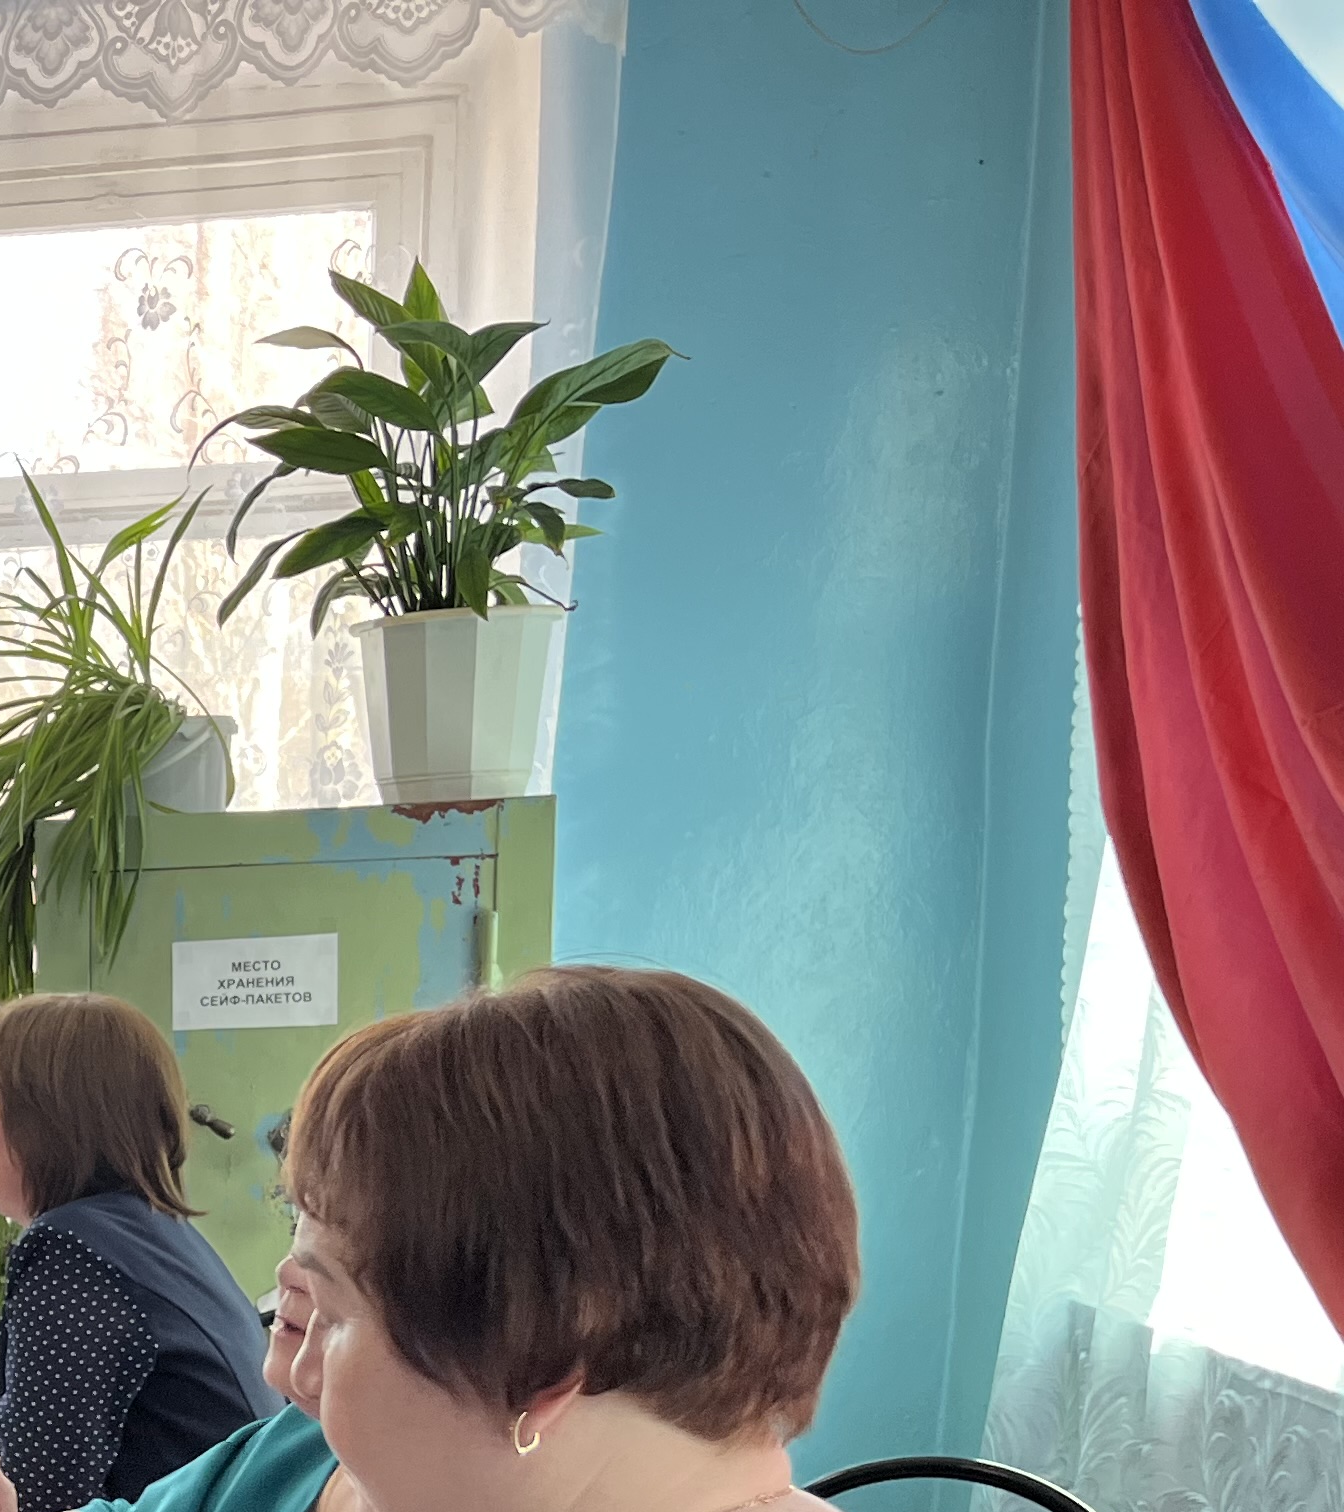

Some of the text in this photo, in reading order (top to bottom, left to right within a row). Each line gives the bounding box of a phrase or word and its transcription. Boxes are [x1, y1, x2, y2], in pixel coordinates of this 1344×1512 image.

[231, 960, 281, 973] МЕСТО
[217, 976, 295, 990] ХРАНЕНИЯ
[199, 991, 313, 1007] СЕЙФ-ПАКЕТОВ
